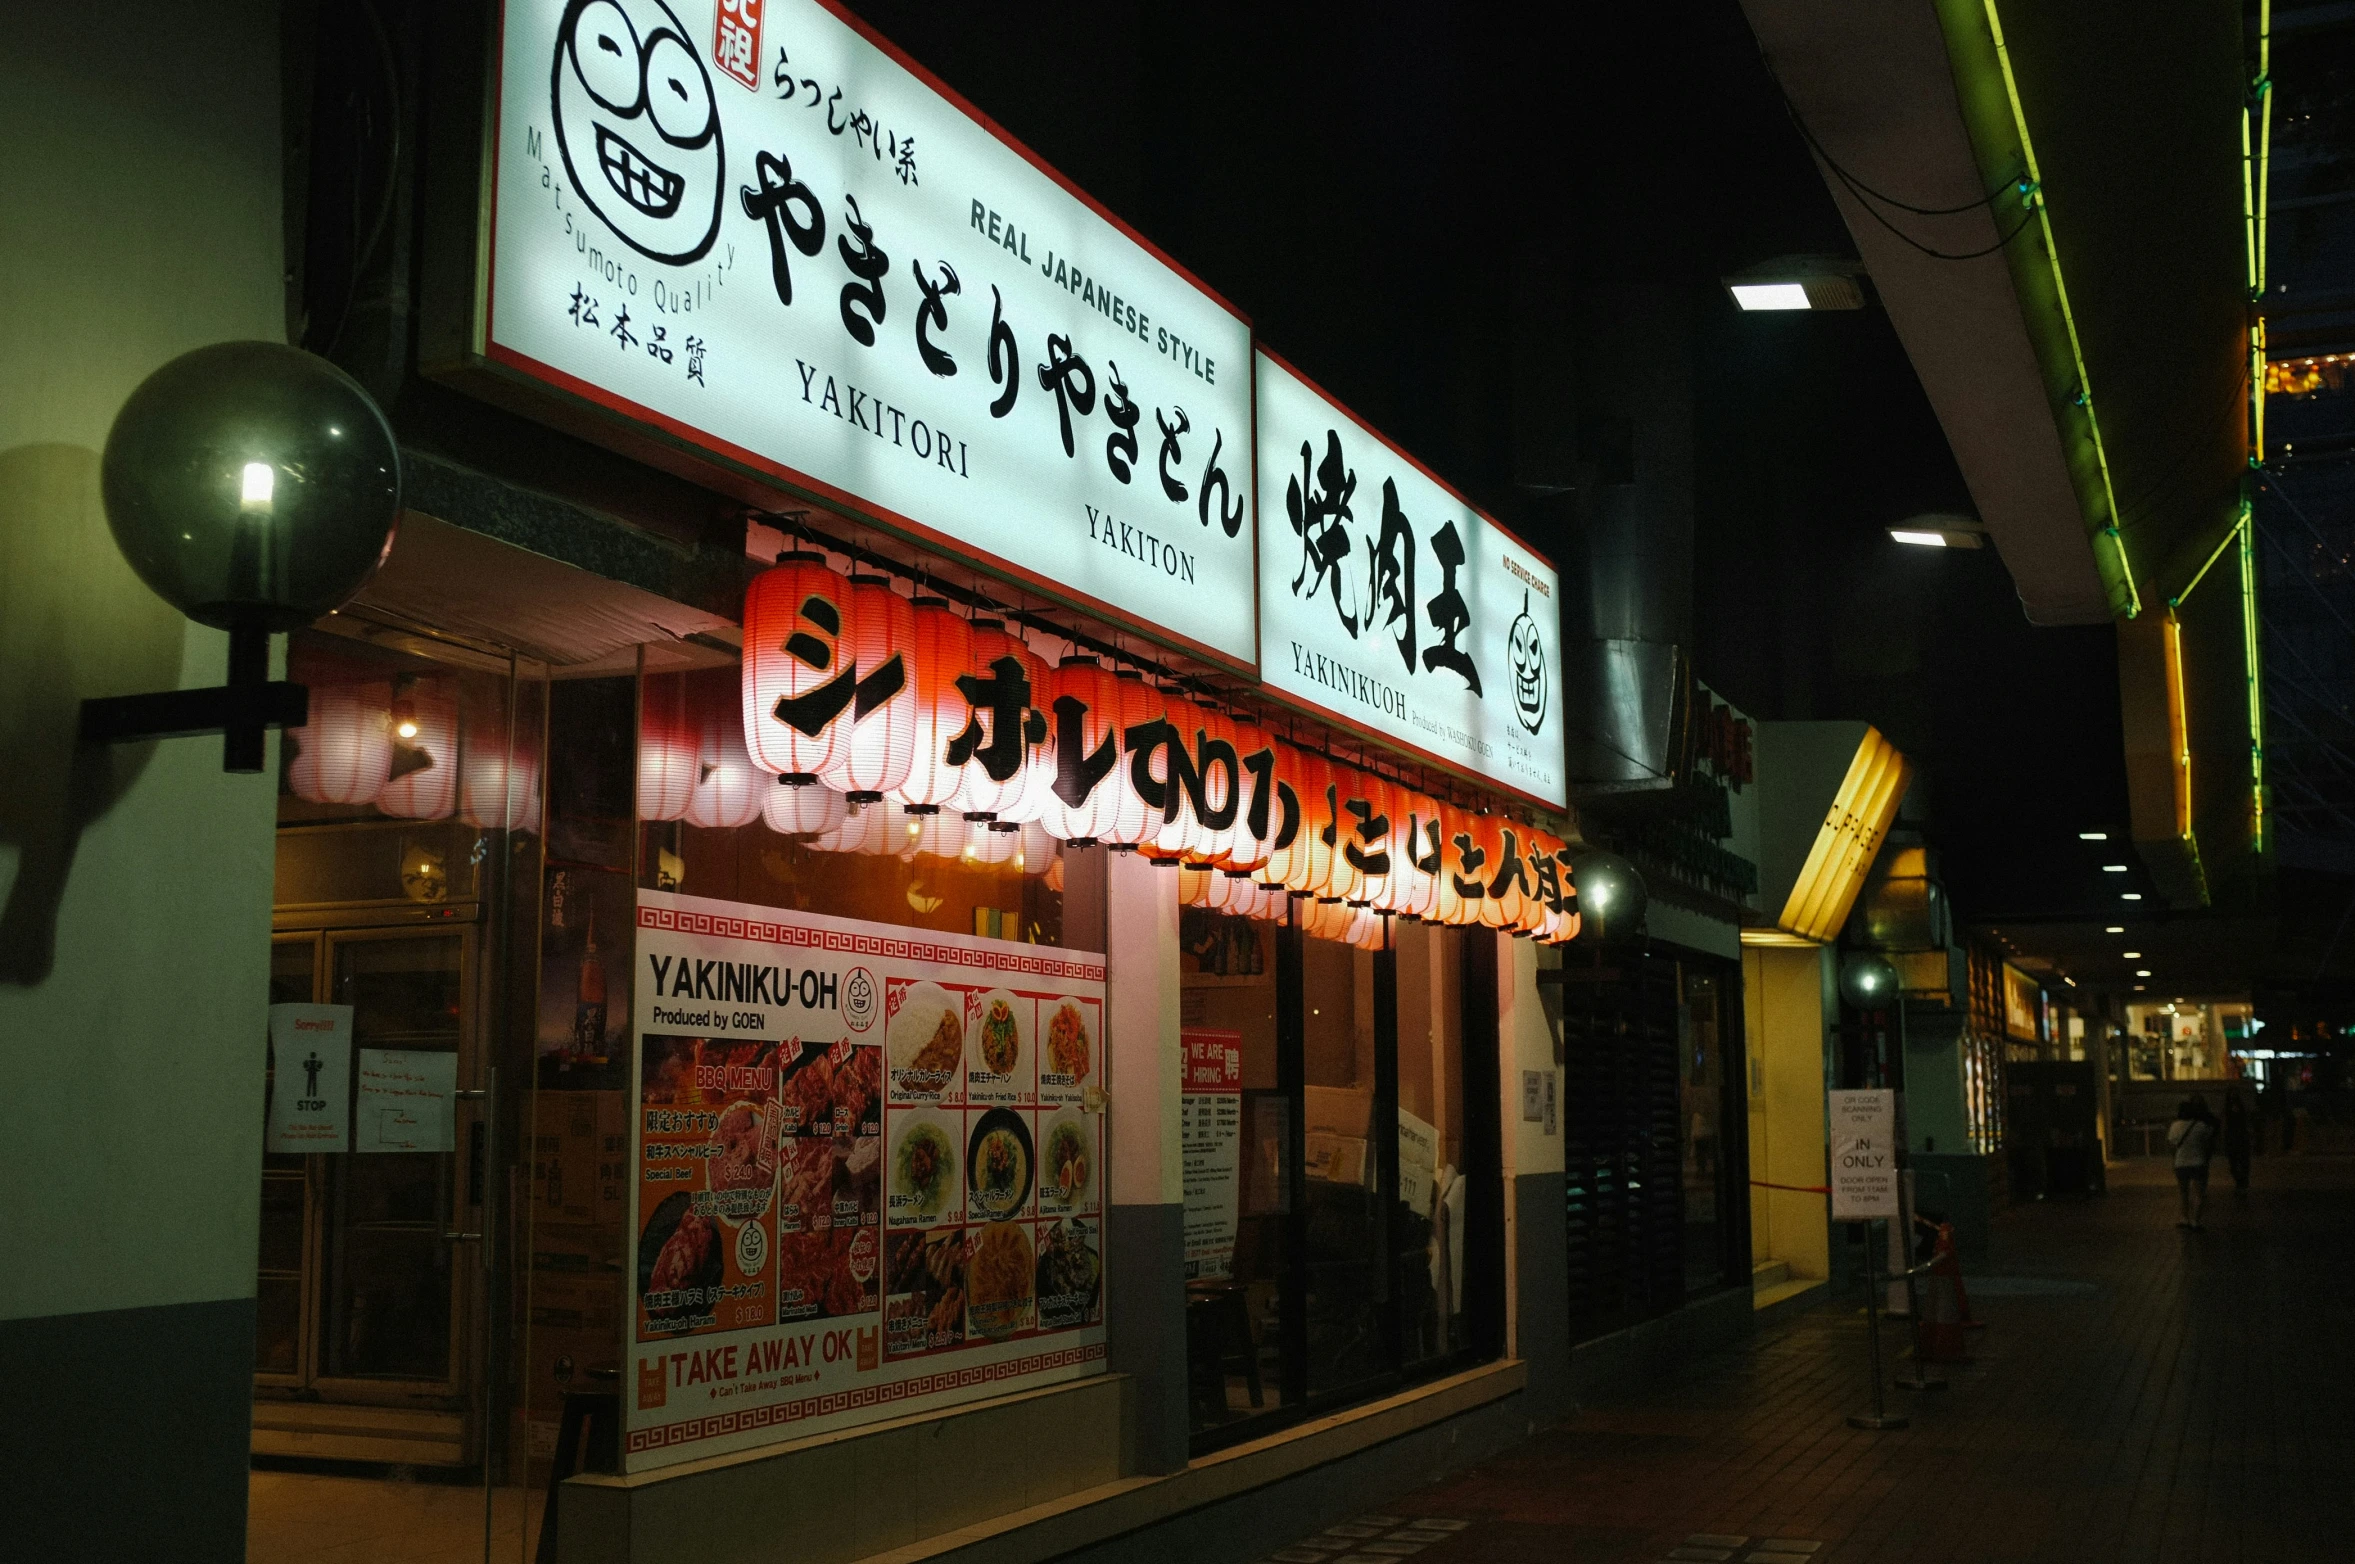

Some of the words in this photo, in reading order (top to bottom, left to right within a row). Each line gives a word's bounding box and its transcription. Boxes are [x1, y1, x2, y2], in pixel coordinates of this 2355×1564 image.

[527, 125, 638, 296] Matsumoto
[654, 243, 735, 315] Quality
[970, 197, 1032, 266] REAL
[1041, 250, 1149, 344] JAPANESE
[1157, 326, 1216, 386] STYLE
[567, 281, 708, 388] 松本品質
[795, 358, 969, 479] YAKITORI
[1084, 503, 1195, 586] YAKITON
[1286, 429, 1484, 699] 焼肉王
[1511, 560, 1531, 585] SERVICE
[1532, 574, 1550, 599] CHARGE
[1291, 640, 1408, 722] YAKINIKUOH
[1412, 709, 1438, 735] Produced
[649, 954, 838, 1010] YAKINIKU-OH
[653, 1006, 710, 1027] Produced
[714, 1010, 728, 1030] by
[732, 1012, 765, 1030] GOEN
[1191, 1042, 1204, 1060] WE
[1207, 1043, 1224, 1060] ARE
[695, 1065, 727, 1093] BBQ
[730, 1067, 773, 1092] MENU
[1193, 1066, 1222, 1084] HIRING
[890, 1090, 912, 1101] Original
[912, 1091, 929, 1101] Curry
[929, 1091, 941, 1100] Rice
[995, 1092, 1007, 1101] Fried
[297, 1100, 327, 1111] STOP
[835, 1107, 849, 1117] ロース
[1842, 1105, 1882, 1114] SCANNING
[646, 1109, 719, 1133] 限定おすすめ
[646, 1144, 726, 1161] 和牛スペシャルビーフ
[1843, 1155, 1885, 1168] ONLY
[646, 1168, 672, 1181] Special
[675, 1167, 692, 1180] Beef
[725, 1164, 731, 1181] $
[734, 1164, 752, 1180] 24.0
[1840, 1177, 1864, 1185] DOOR
[1842, 1186, 1865, 1194] FROM
[889, 1215, 918, 1226] Nagahama
[918, 1214, 937, 1224] Ramen
[644, 1315, 688, 1332] Yakiniku-oh
[689, 1313, 717, 1328] Harami
[735, 1308, 742, 1324] $
[745, 1305, 764, 1321] 18.0
[670, 1345, 738, 1387] TAKE
[745, 1334, 816, 1376] AWAY
[822, 1328, 853, 1363] OK
[645, 1376, 661, 1388] TAKE
[719, 1385, 738, 1398] Can't
[740, 1381, 757, 1393] Take
[758, 1379, 777, 1391] Away
[780, 1375, 794, 1386] BBQ
[795, 1373, 813, 1385] Menu
